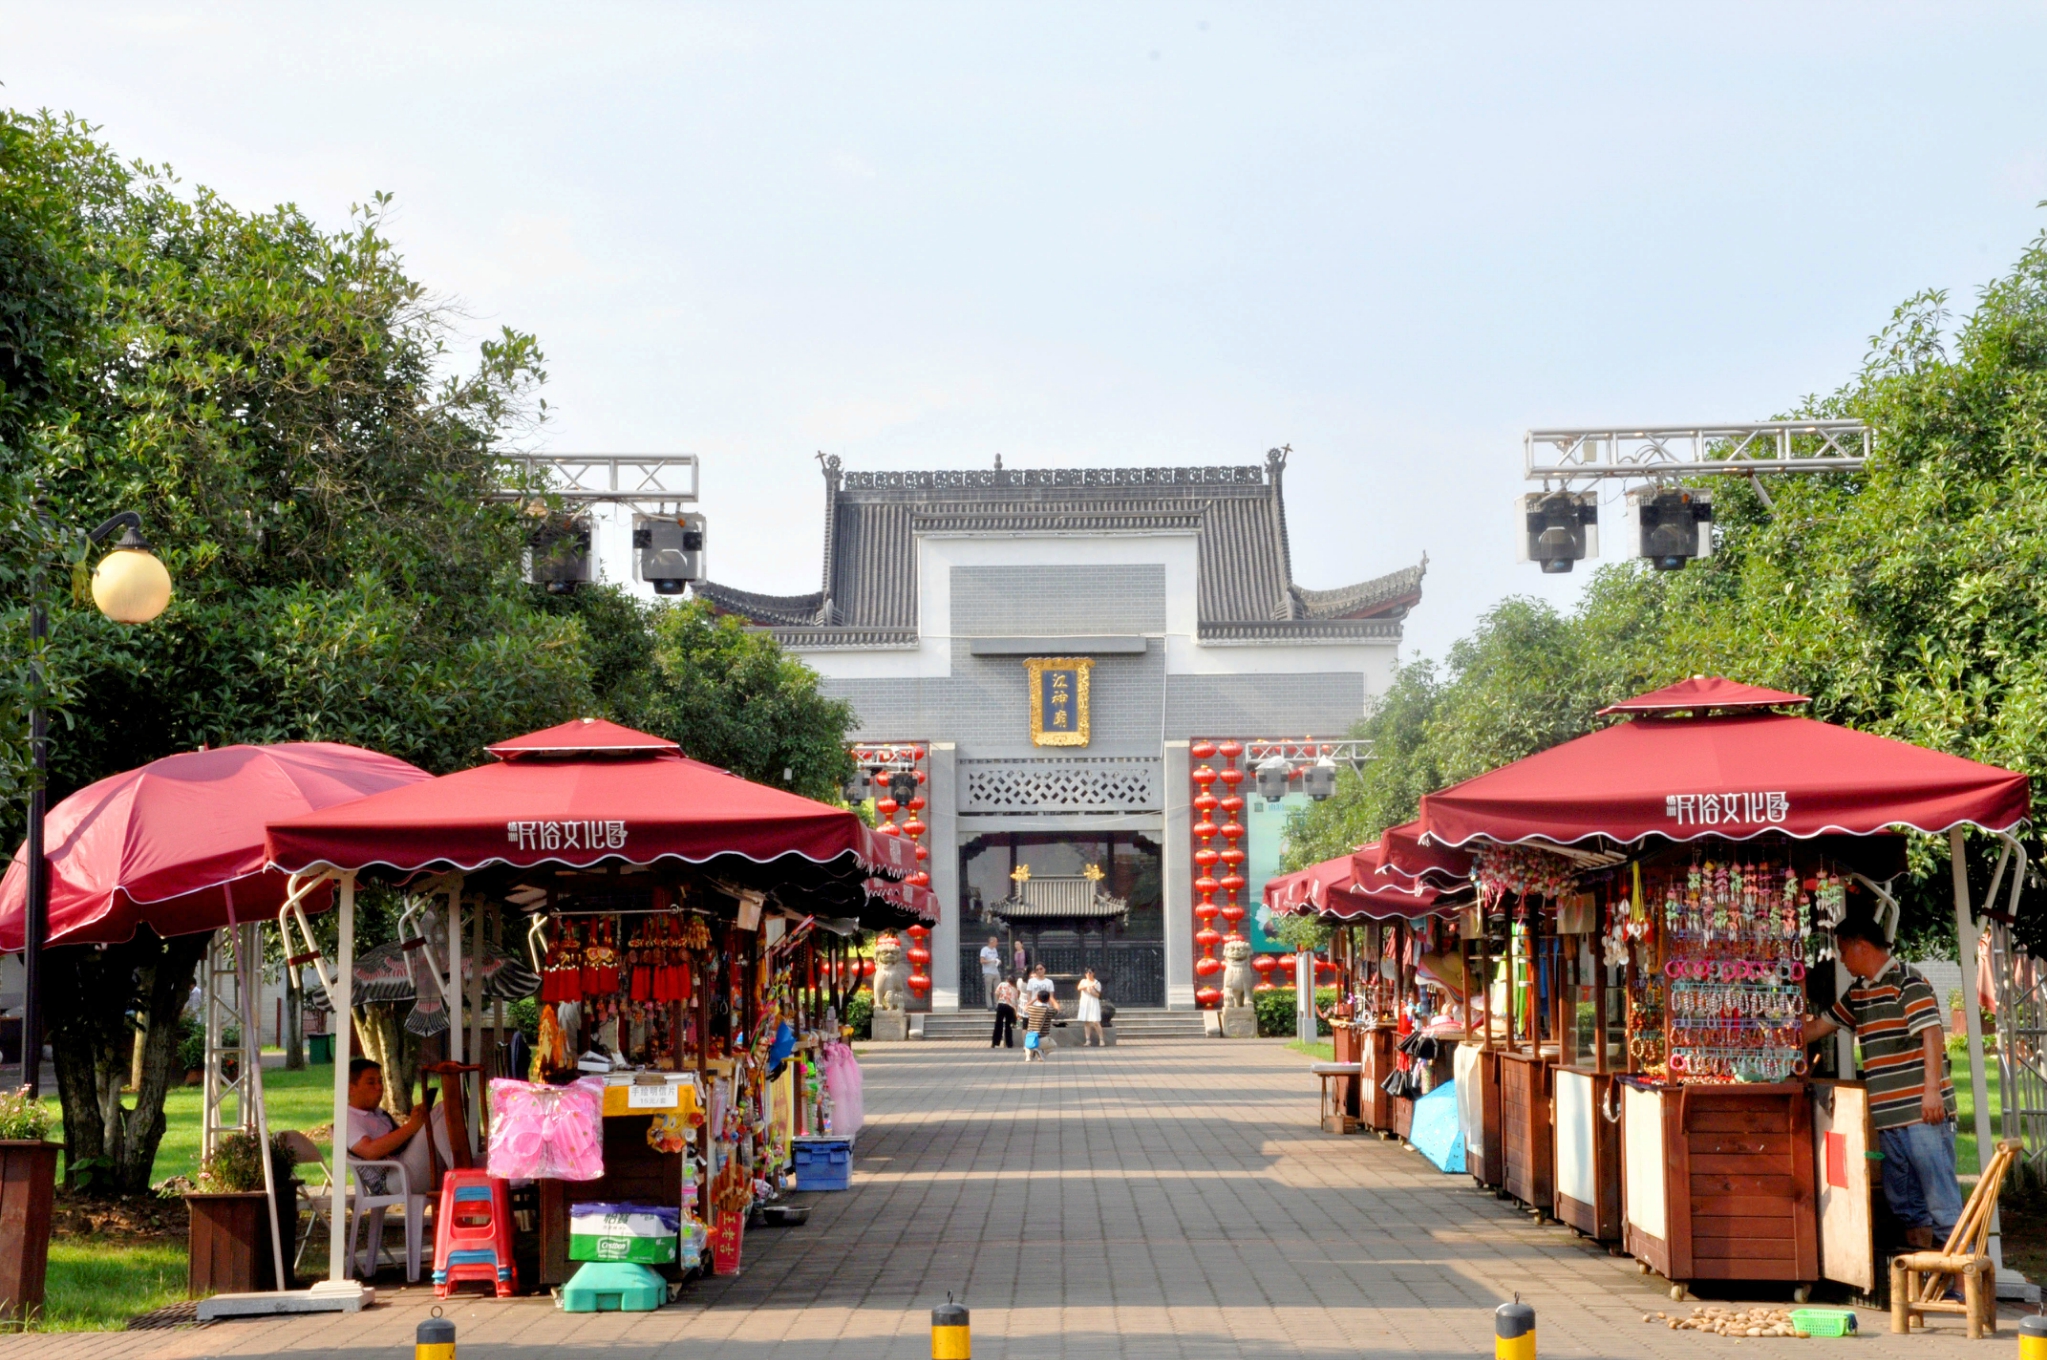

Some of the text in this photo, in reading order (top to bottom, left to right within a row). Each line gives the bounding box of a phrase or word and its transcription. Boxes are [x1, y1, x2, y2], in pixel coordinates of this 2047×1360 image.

[631, 1085, 676, 1097] 手绘明信片
[720, 1212, 736, 1256] 王老吉
